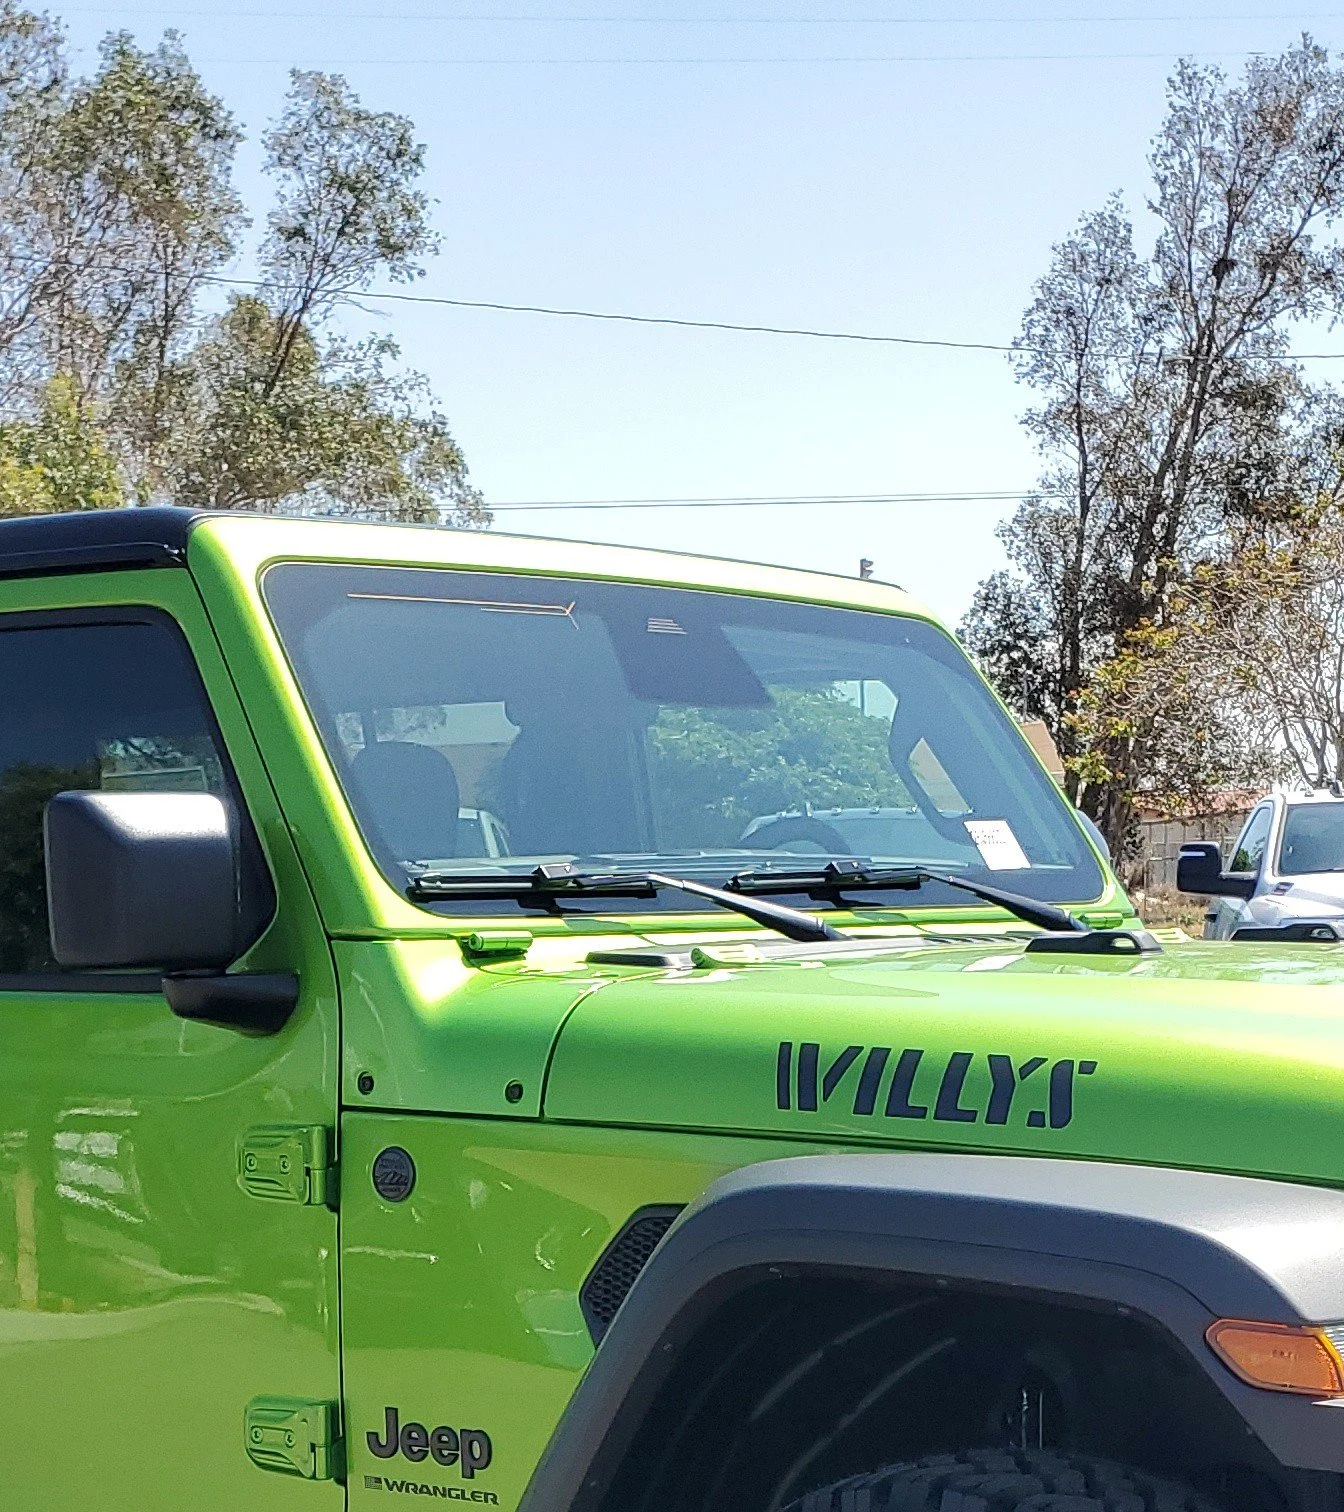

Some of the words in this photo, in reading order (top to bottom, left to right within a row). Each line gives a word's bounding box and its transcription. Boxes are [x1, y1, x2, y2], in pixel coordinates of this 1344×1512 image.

[775, 1041, 1099, 1130] WILLYS
[366, 1406, 493, 1480] Jeep
[383, 1477, 500, 1506] WRANGLER
